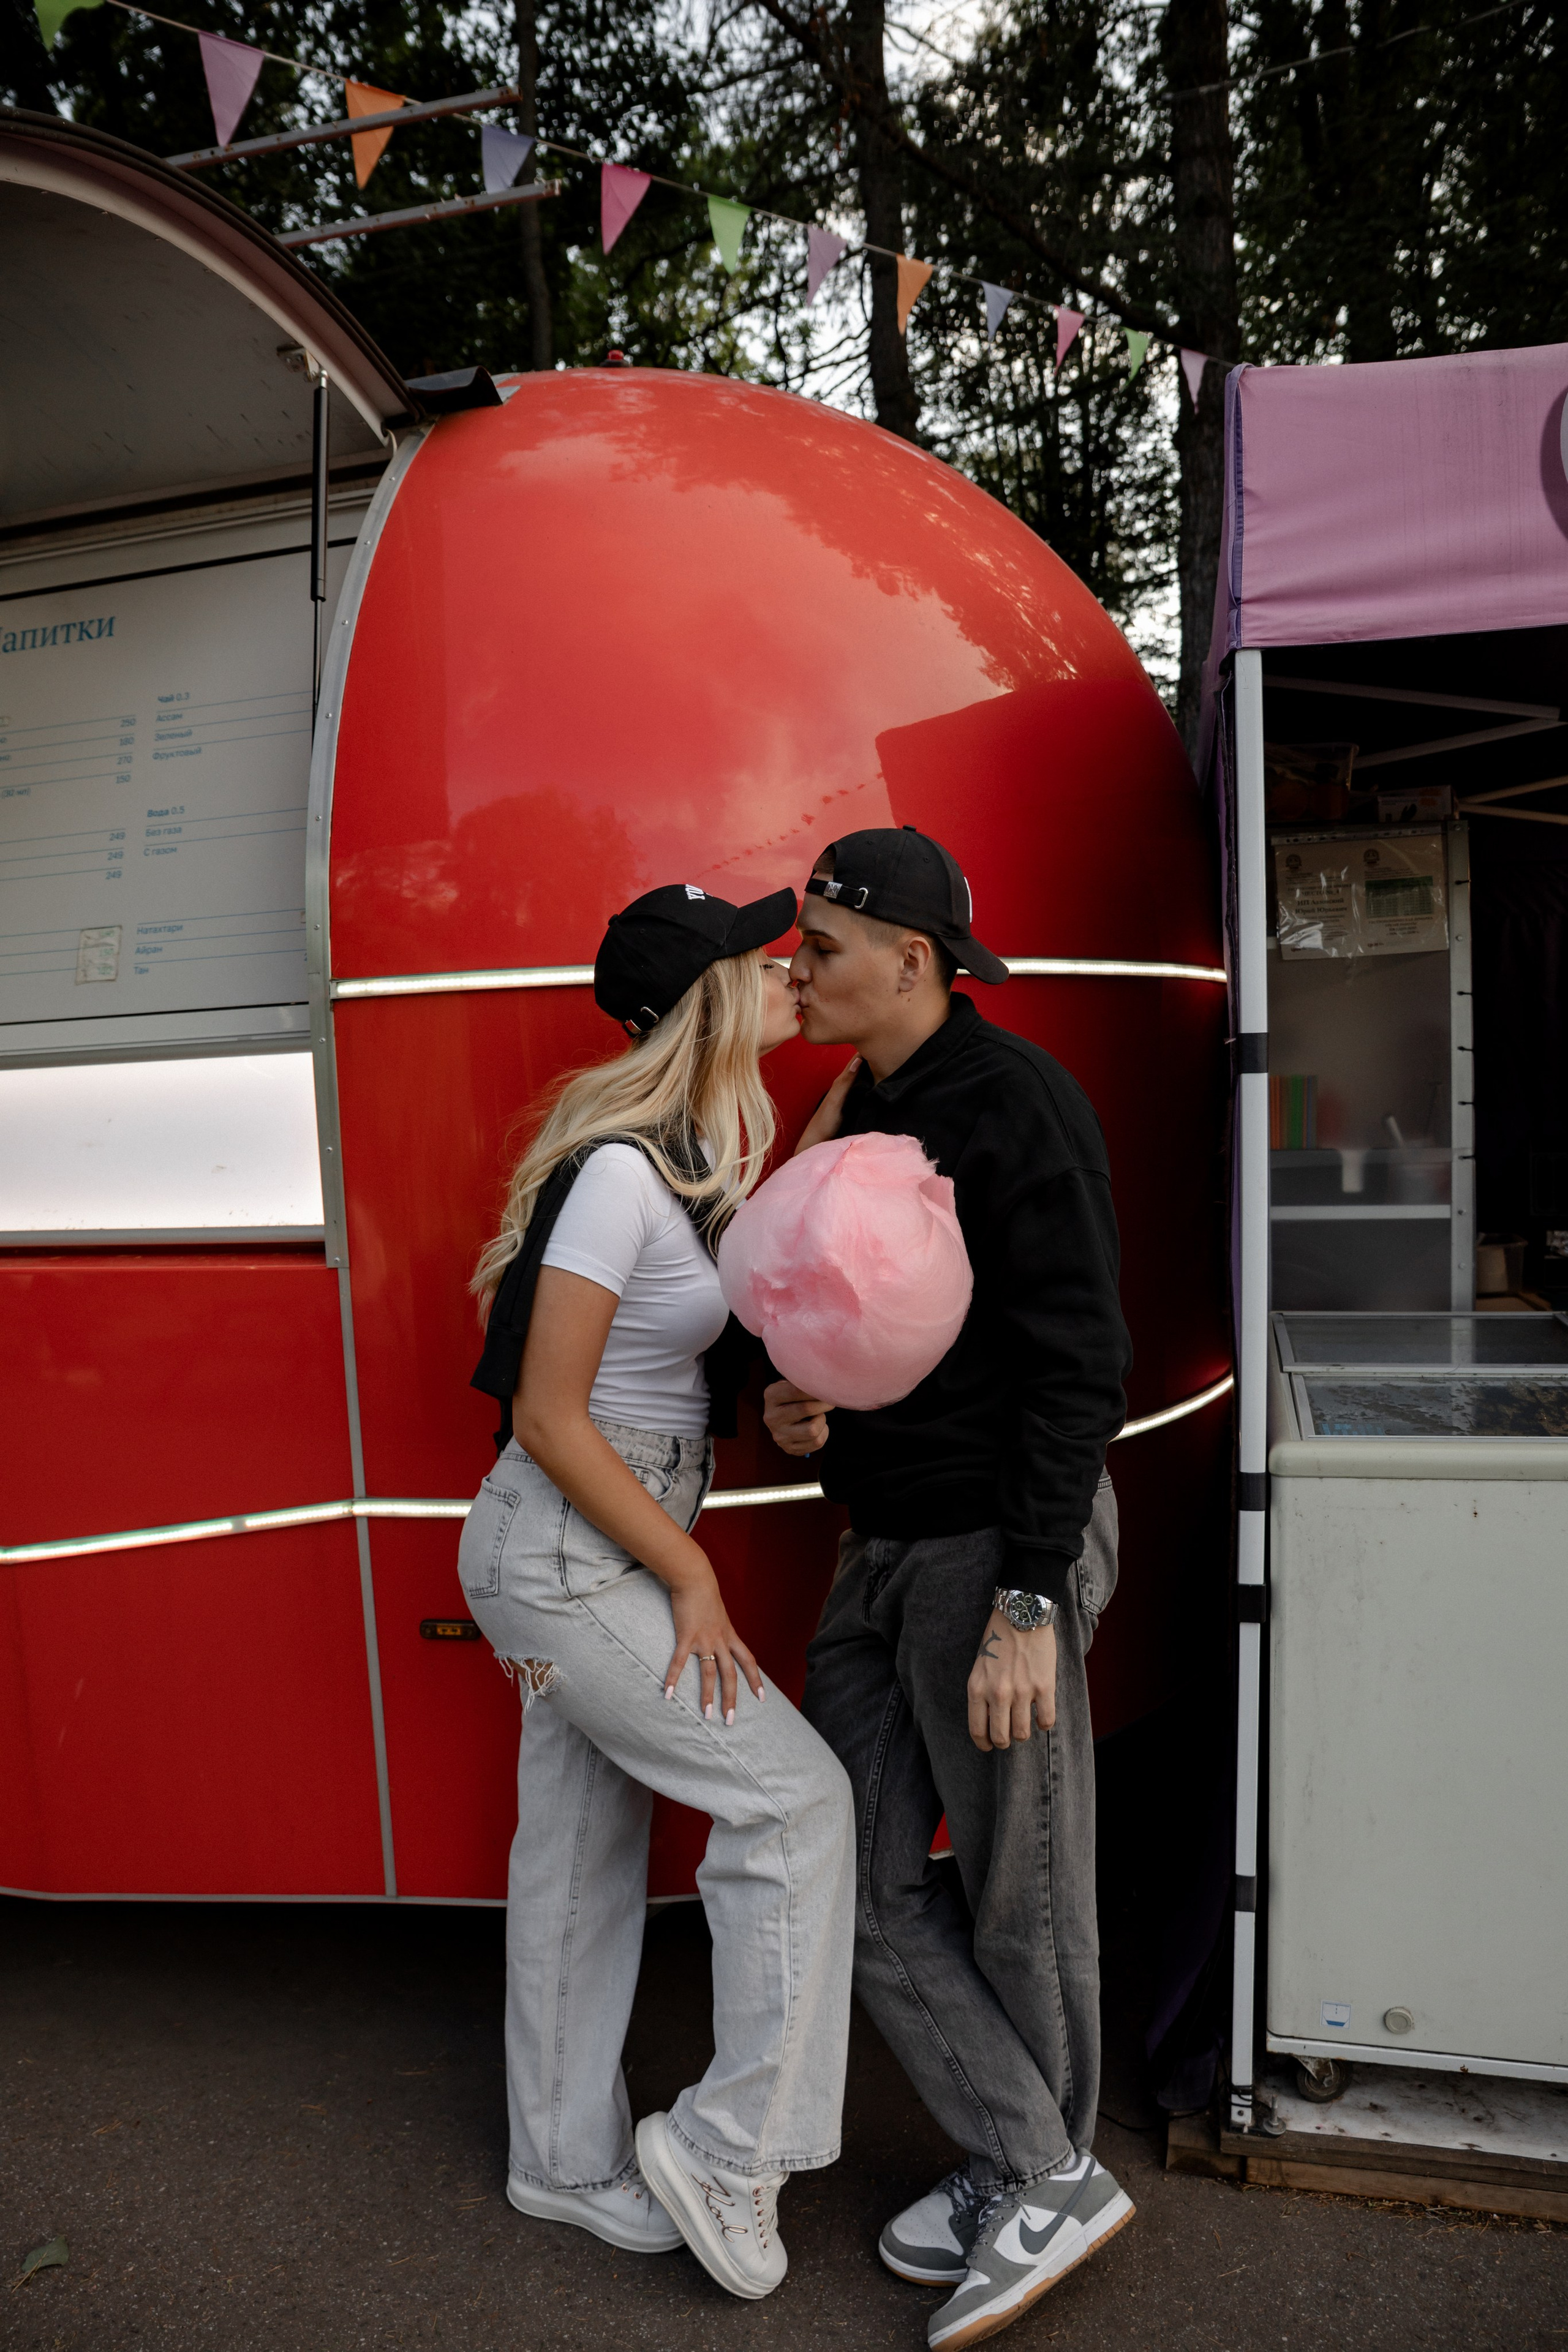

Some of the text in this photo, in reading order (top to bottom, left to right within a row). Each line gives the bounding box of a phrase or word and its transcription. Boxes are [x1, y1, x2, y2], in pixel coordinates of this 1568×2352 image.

[0, 616, 115, 653] апитки
[153, 747, 202, 760] Фруктовый
[116, 756, 133, 765] 270
[147, 805, 185, 818] Вода 0.5
[163, 827, 182, 835] газа
[143, 847, 177, 856] С газом
[137, 925, 183, 935] Натахтари
[135, 946, 162, 955] Айран
[133, 967, 149, 975] Тан
